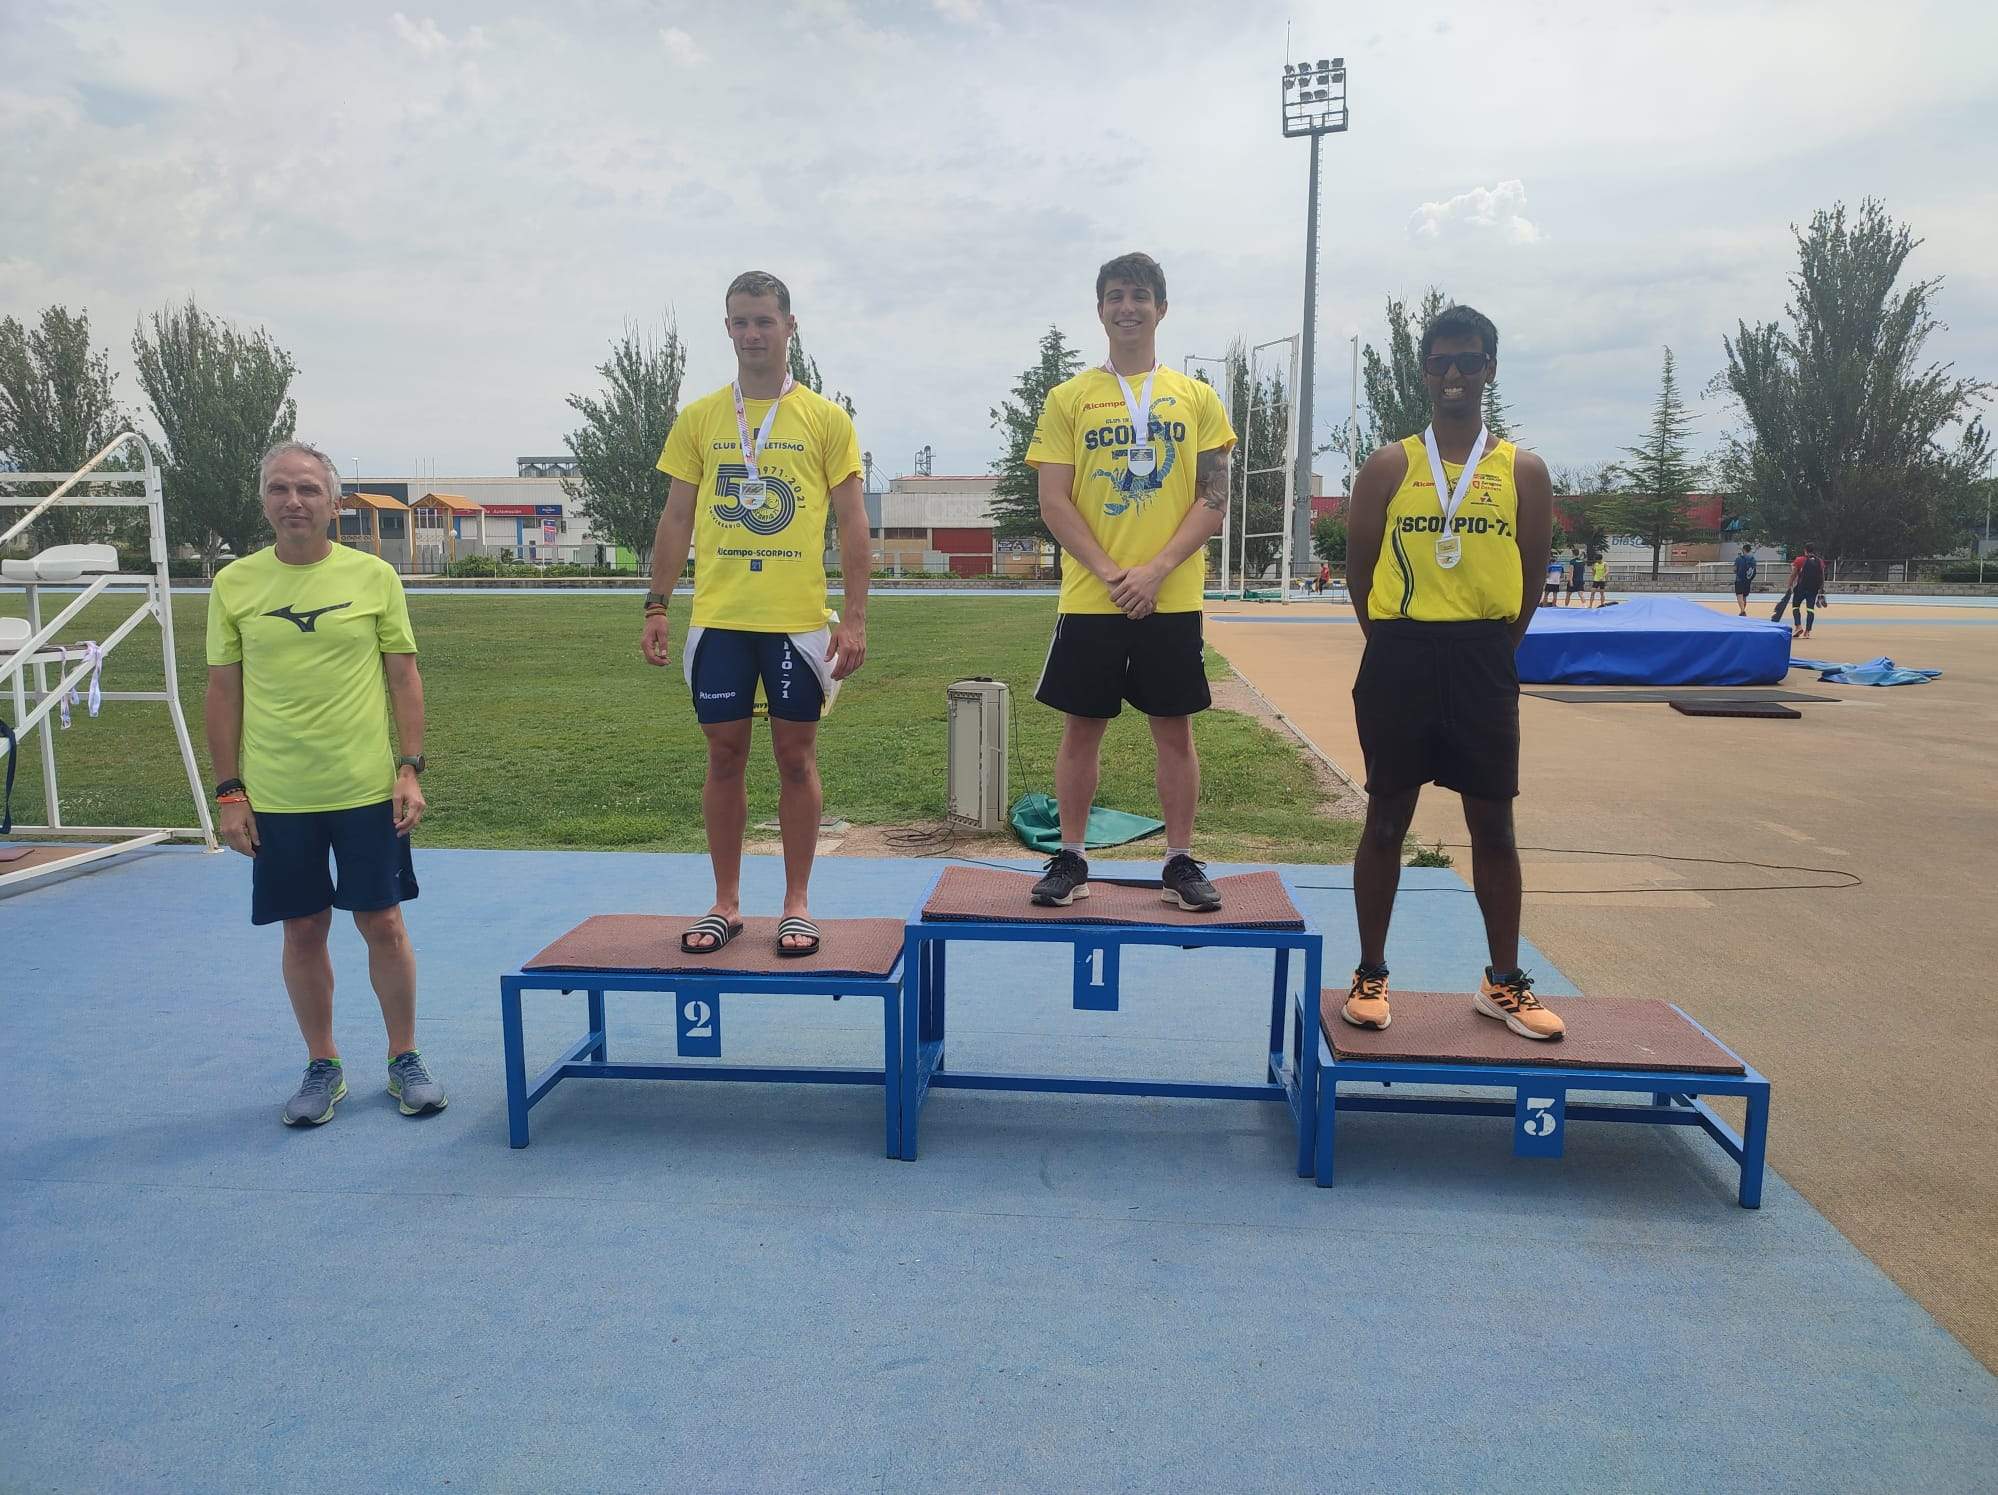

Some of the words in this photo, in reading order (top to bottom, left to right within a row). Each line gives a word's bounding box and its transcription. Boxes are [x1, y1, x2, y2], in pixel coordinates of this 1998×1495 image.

[1083, 401, 1126, 411] Alcampo
[713, 442, 736, 450] CLUB
[699, 691, 736, 700] Alcampo
[1088, 948, 1105, 987] 1
[684, 1002, 712, 1037] 2
[1524, 1097, 1556, 1137] 3
